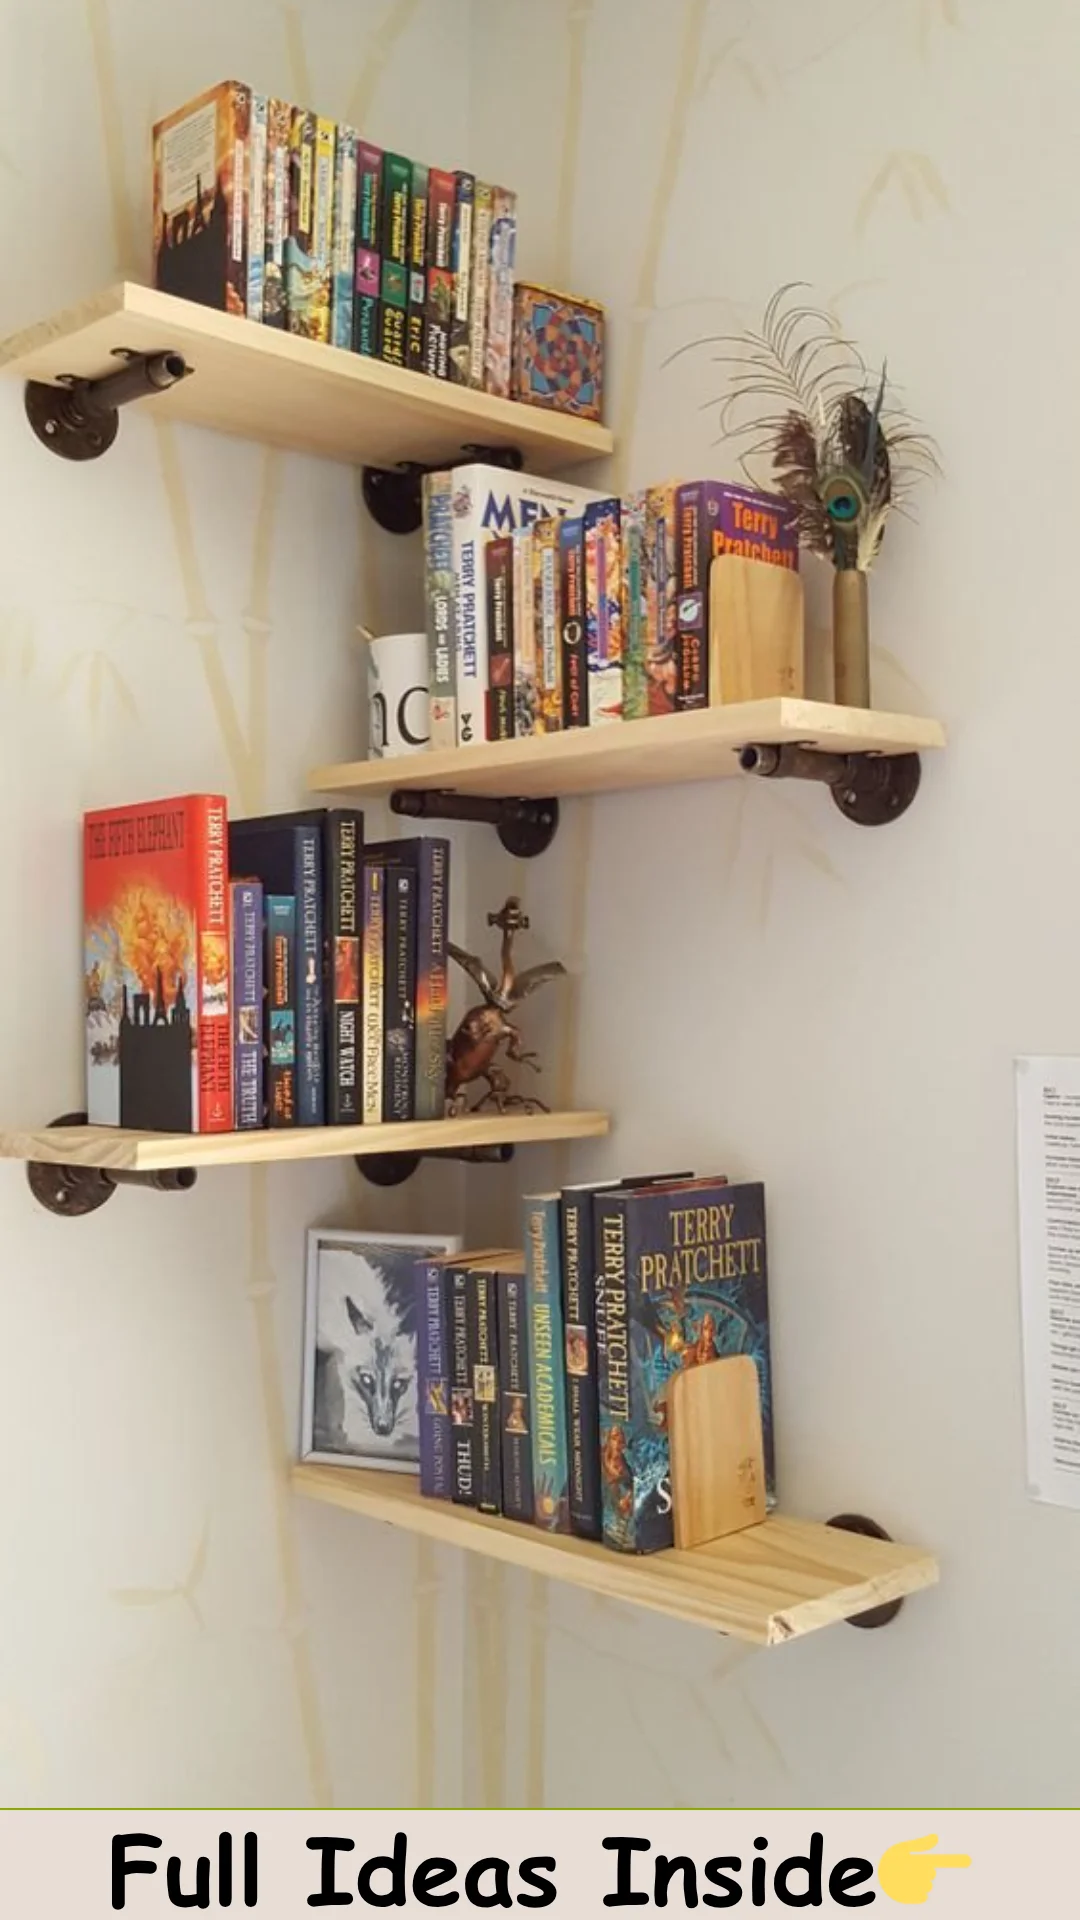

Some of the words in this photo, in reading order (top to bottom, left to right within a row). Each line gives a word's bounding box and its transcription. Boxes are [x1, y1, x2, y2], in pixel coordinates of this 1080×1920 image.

[360, 298, 374, 355] Pyramid
[682, 506, 694, 535] Terry
[732, 501, 778, 540] Terry
[462, 540, 476, 587] TERRY
[682, 536, 693, 588] Pratchett
[462, 593, 478, 678] PRATCHETT
[207, 806, 223, 848] TERRY
[340, 821, 356, 858] TERRY
[304, 838, 316, 878] TERRY
[432, 848, 444, 884] TERRY
[208, 850, 224, 925] PRATCHETT
[340, 860, 356, 932] PRATCHETT
[244, 912, 256, 942] TERRY
[304, 879, 317, 954] PRATCHETT
[431, 886, 444, 954] PRATCHETT
[244, 944, 256, 1002] PRATCHETT
[218, 1024, 230, 1050] THE
[339, 1010, 355, 1044] NIGHT
[218, 1053, 230, 1093] FIFTH
[241, 1051, 258, 1076] THE
[339, 1047, 355, 1087] WATCH
[241, 1080, 258, 1124] TRUTH
[566, 1206, 578, 1246] TERRY
[669, 1204, 734, 1246] TERRY
[602, 1214, 626, 1285] TERRY
[640, 1238, 761, 1293] PRATCHETT
[427, 1286, 440, 1316] TERRY
[477, 1279, 487, 1307] TERRY
[567, 1248, 579, 1322] PRATCHETT
[454, 1296, 466, 1324] TERRY
[534, 1304, 553, 1358] UNSEEN
[428, 1318, 441, 1374] PRATCHETT
[606, 1288, 630, 1421] PRATCHETT
[536, 1363, 557, 1466] ACADEMICALS
[456, 1440, 472, 1495] THUD!
